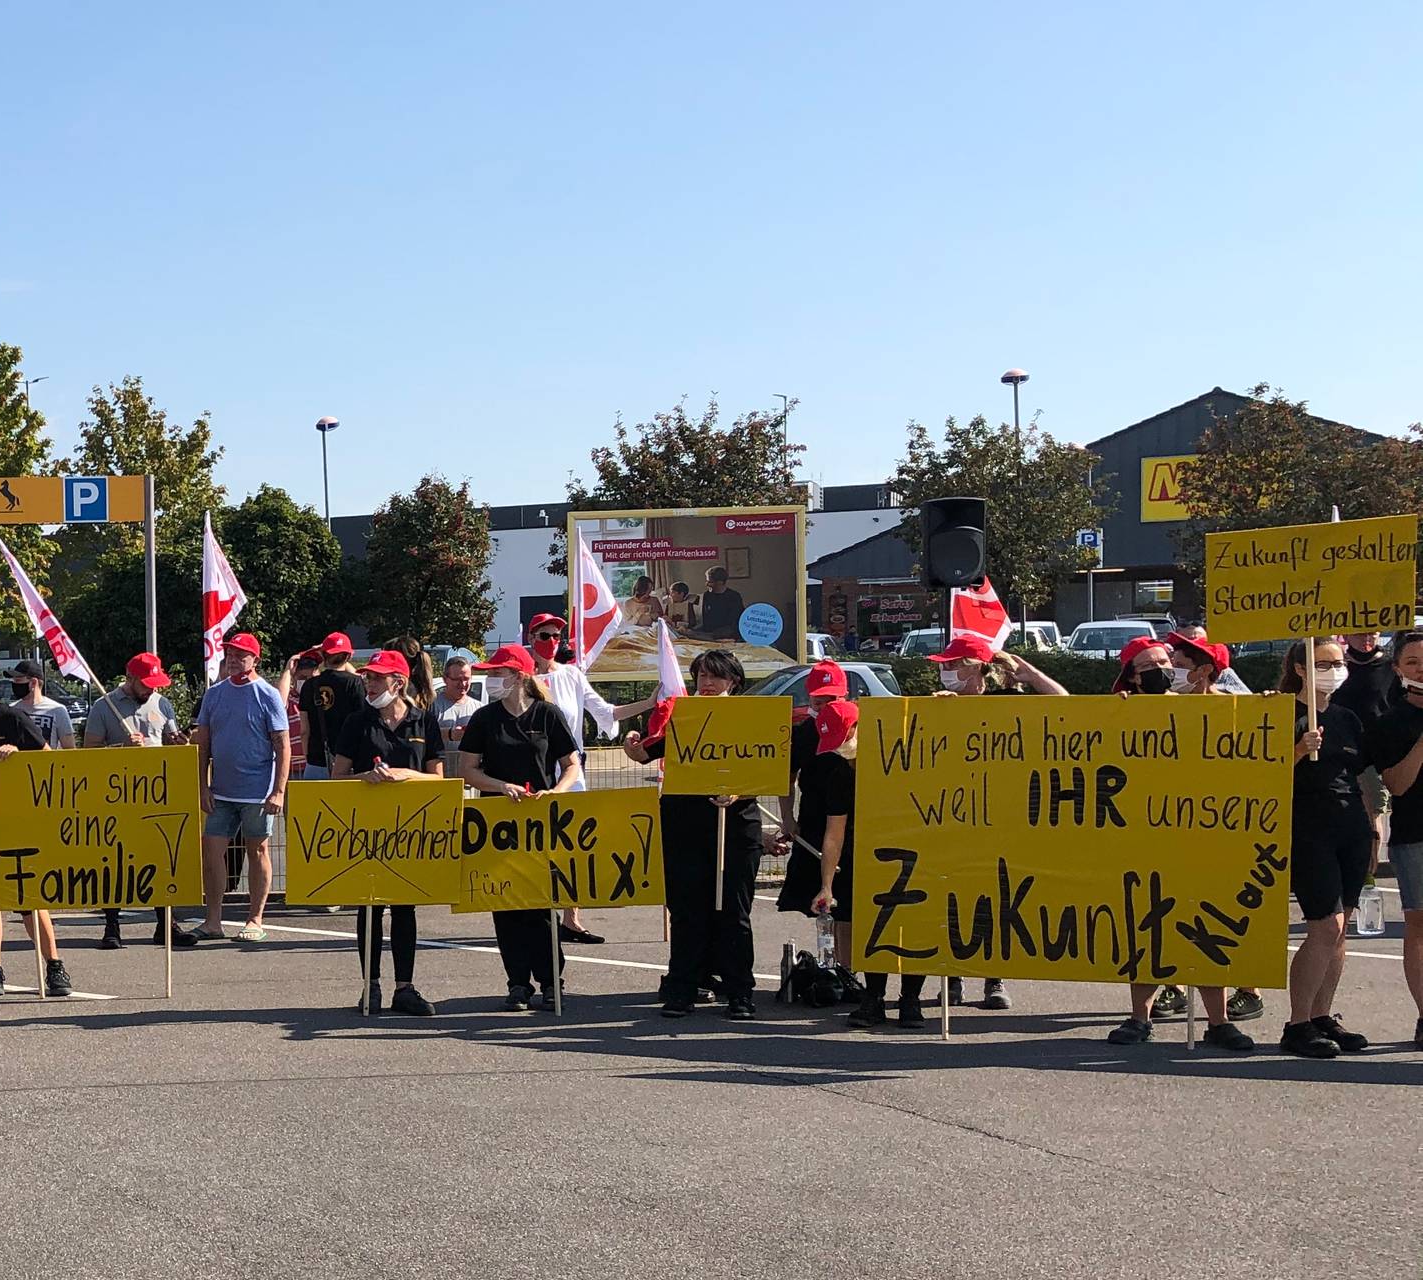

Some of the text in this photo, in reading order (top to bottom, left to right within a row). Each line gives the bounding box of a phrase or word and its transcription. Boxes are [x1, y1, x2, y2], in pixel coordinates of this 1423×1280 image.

[73, 483, 99, 517] P
[736, 519, 787, 527] KNAPPSCHAFT
[1084, 534, 1095, 544] P
[594, 541, 639, 550] Füreinander
[652, 540, 671, 548] sein.
[605, 549, 716, 559] Mit der richtigen Krankenkasse
[1213, 532, 1418, 571] Zukunft gestalten
[1213, 579, 1325, 615] Standort
[1288, 601, 1410, 633] erhalten
[877, 713, 947, 776] Wir
[965, 717, 1023, 762] sind
[1043, 717, 1102, 761] hier
[1121, 713, 1177, 760] und
[27, 760, 168, 808] Wir sind
[910, 764, 1279, 833] weil IHR unsere
[60, 811, 117, 847] eine
[465, 869, 511, 902] für
[864, 848, 1177, 982] Zukunft
